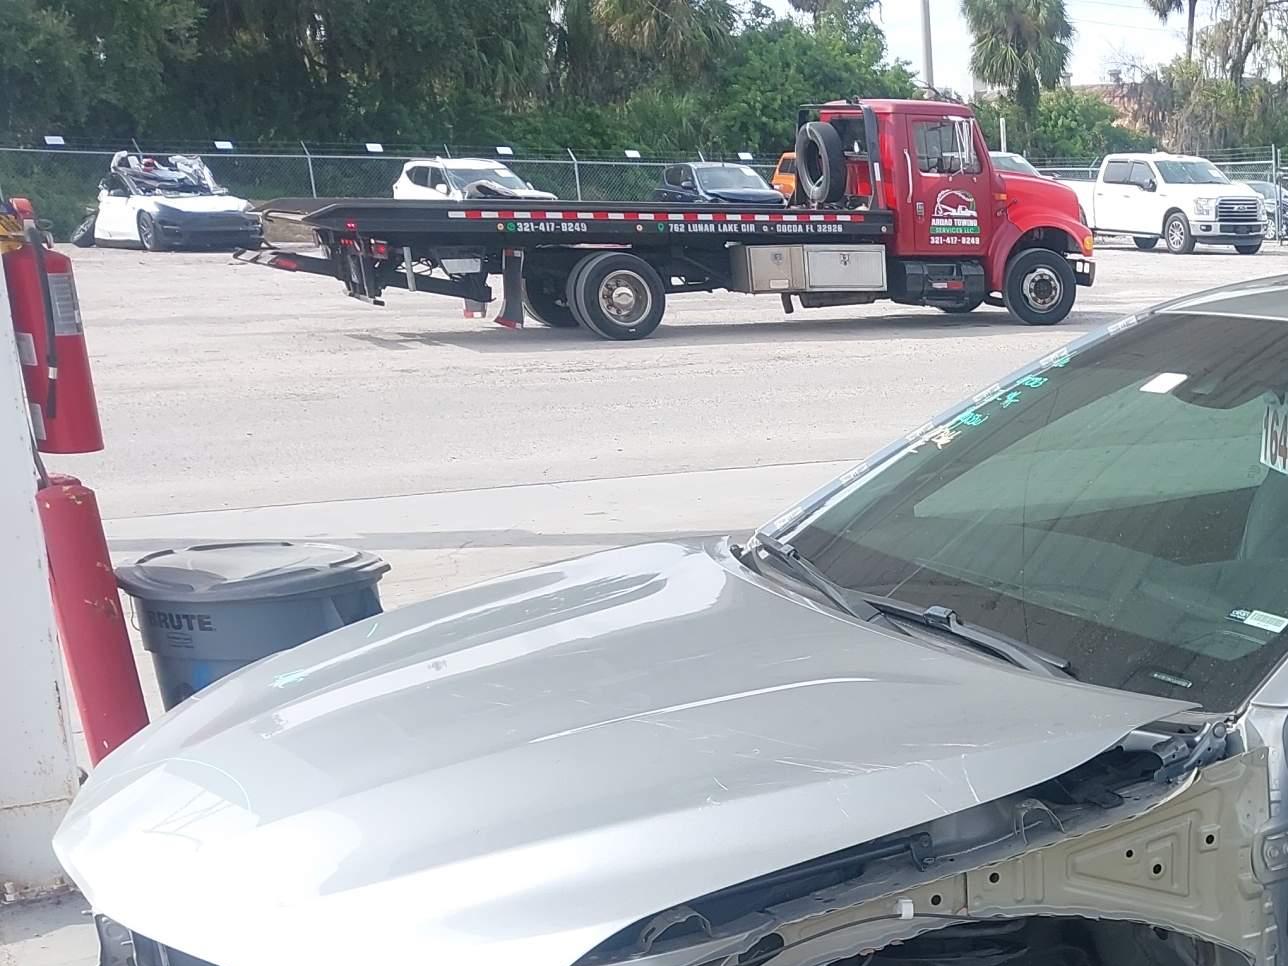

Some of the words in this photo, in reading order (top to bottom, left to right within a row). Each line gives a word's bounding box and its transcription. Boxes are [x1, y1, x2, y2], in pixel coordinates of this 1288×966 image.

[516, 222, 588, 232] 321-417-8249
[668, 223, 685, 232] 762
[688, 223, 715, 233] LUNAR
[718, 223, 739, 233] LAKE
[741, 223, 756, 233] CIR
[776, 224, 803, 233] COCOA
[805, 224, 815, 233] FL
[930, 236, 980, 244] 321-417-8249
[146, 611, 213, 632] BRUTE
